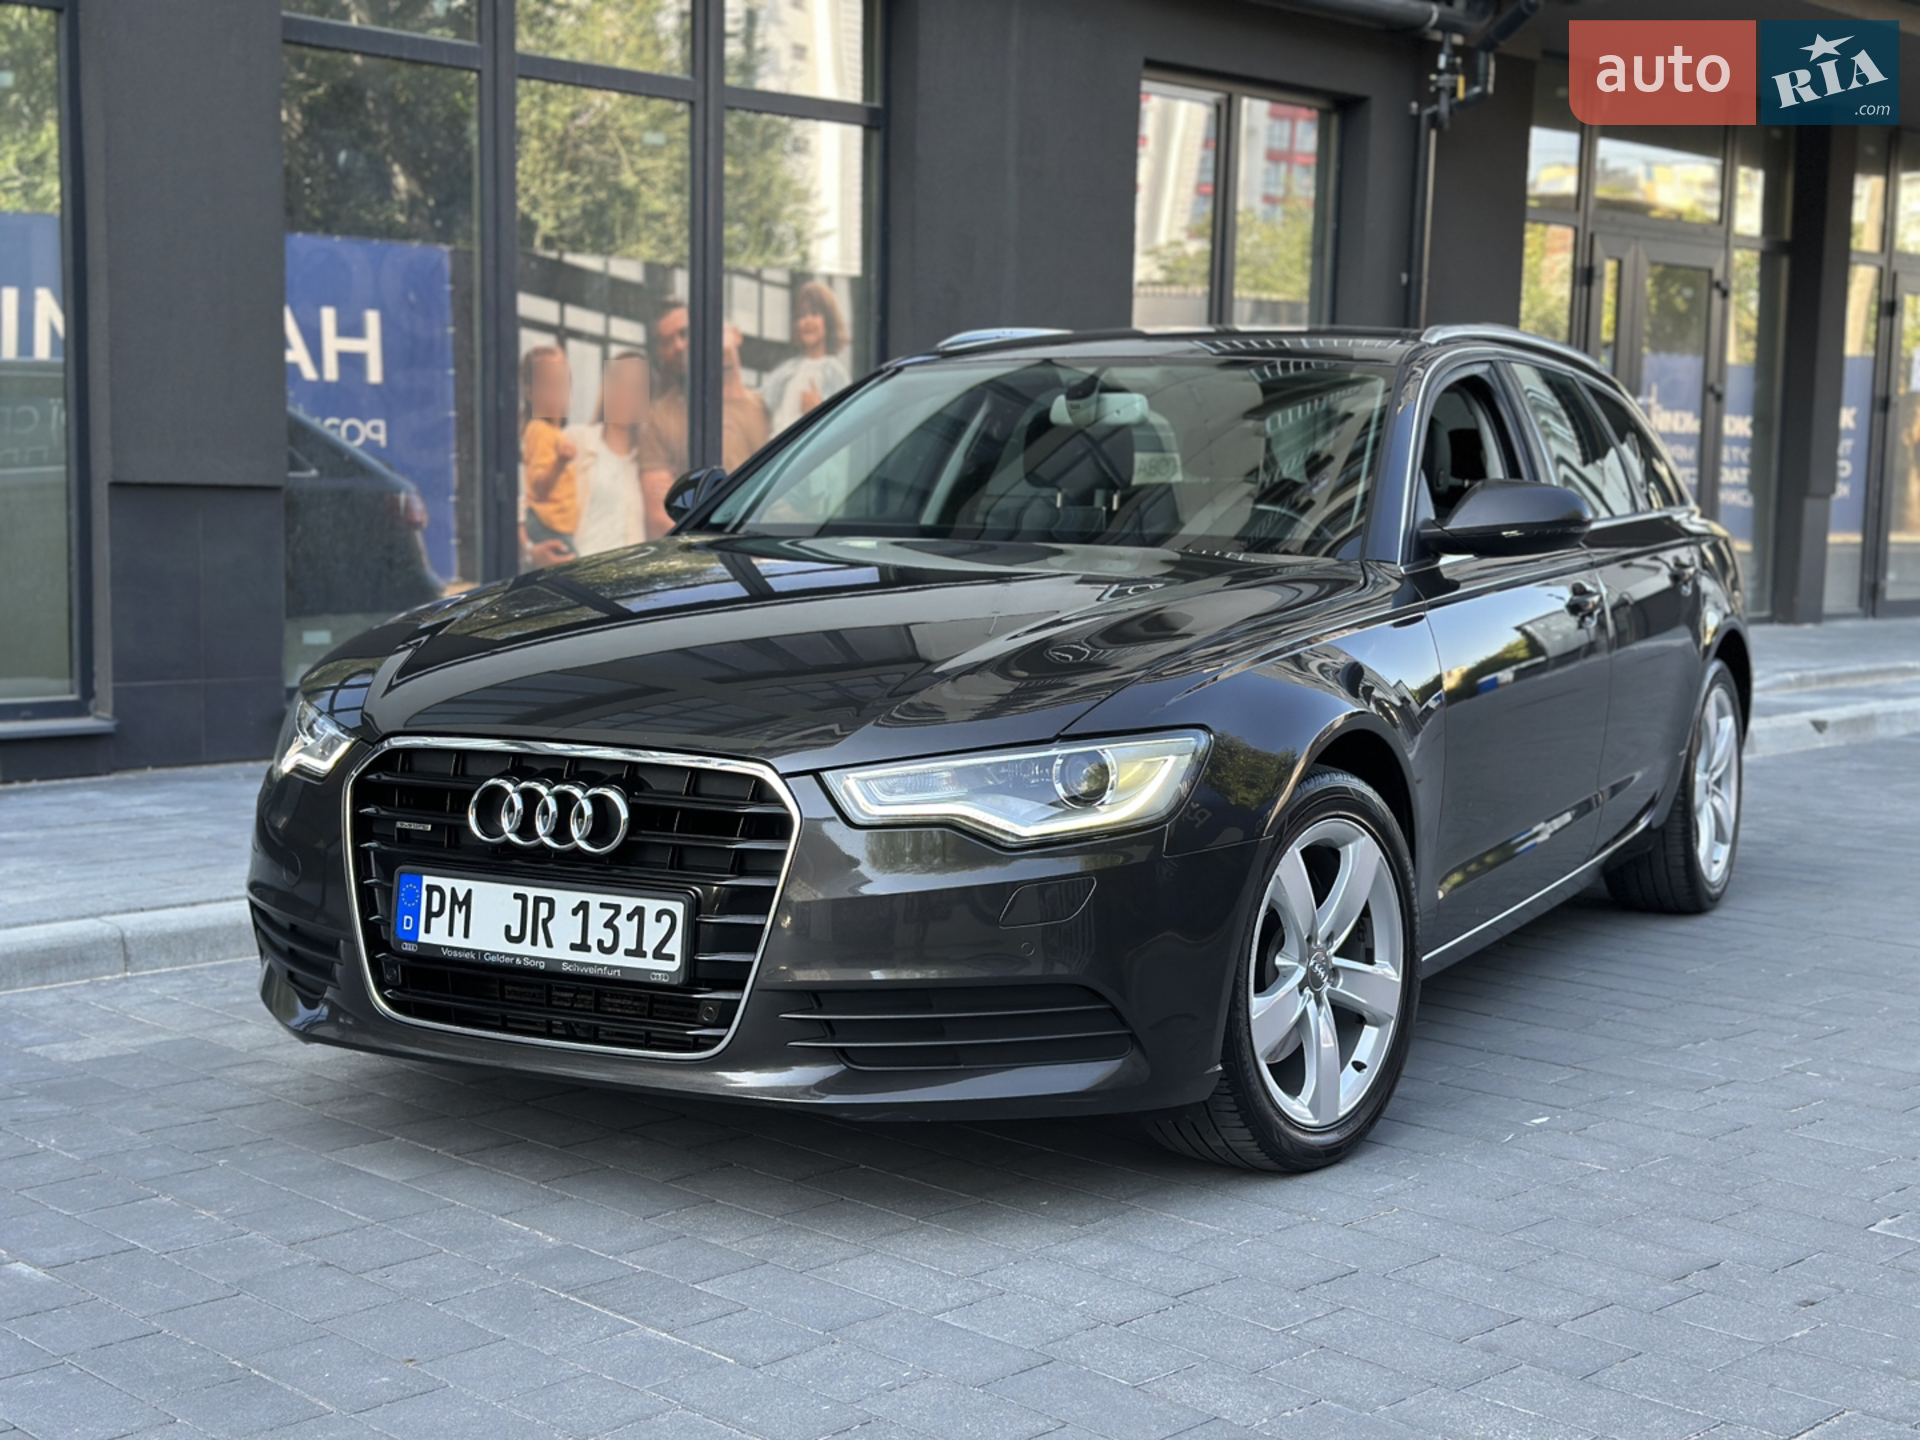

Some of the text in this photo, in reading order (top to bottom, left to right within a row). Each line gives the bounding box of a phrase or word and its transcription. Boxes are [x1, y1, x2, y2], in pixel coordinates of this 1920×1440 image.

[403, 915, 413, 931] D
[424, 883, 678, 962] PM JR 1312
[441, 946, 476, 960] Vossiek
[483, 951, 514, 965] Gelder
[523, 956, 546, 970] Sorg
[561, 961, 621, 977] Schweinfurt
